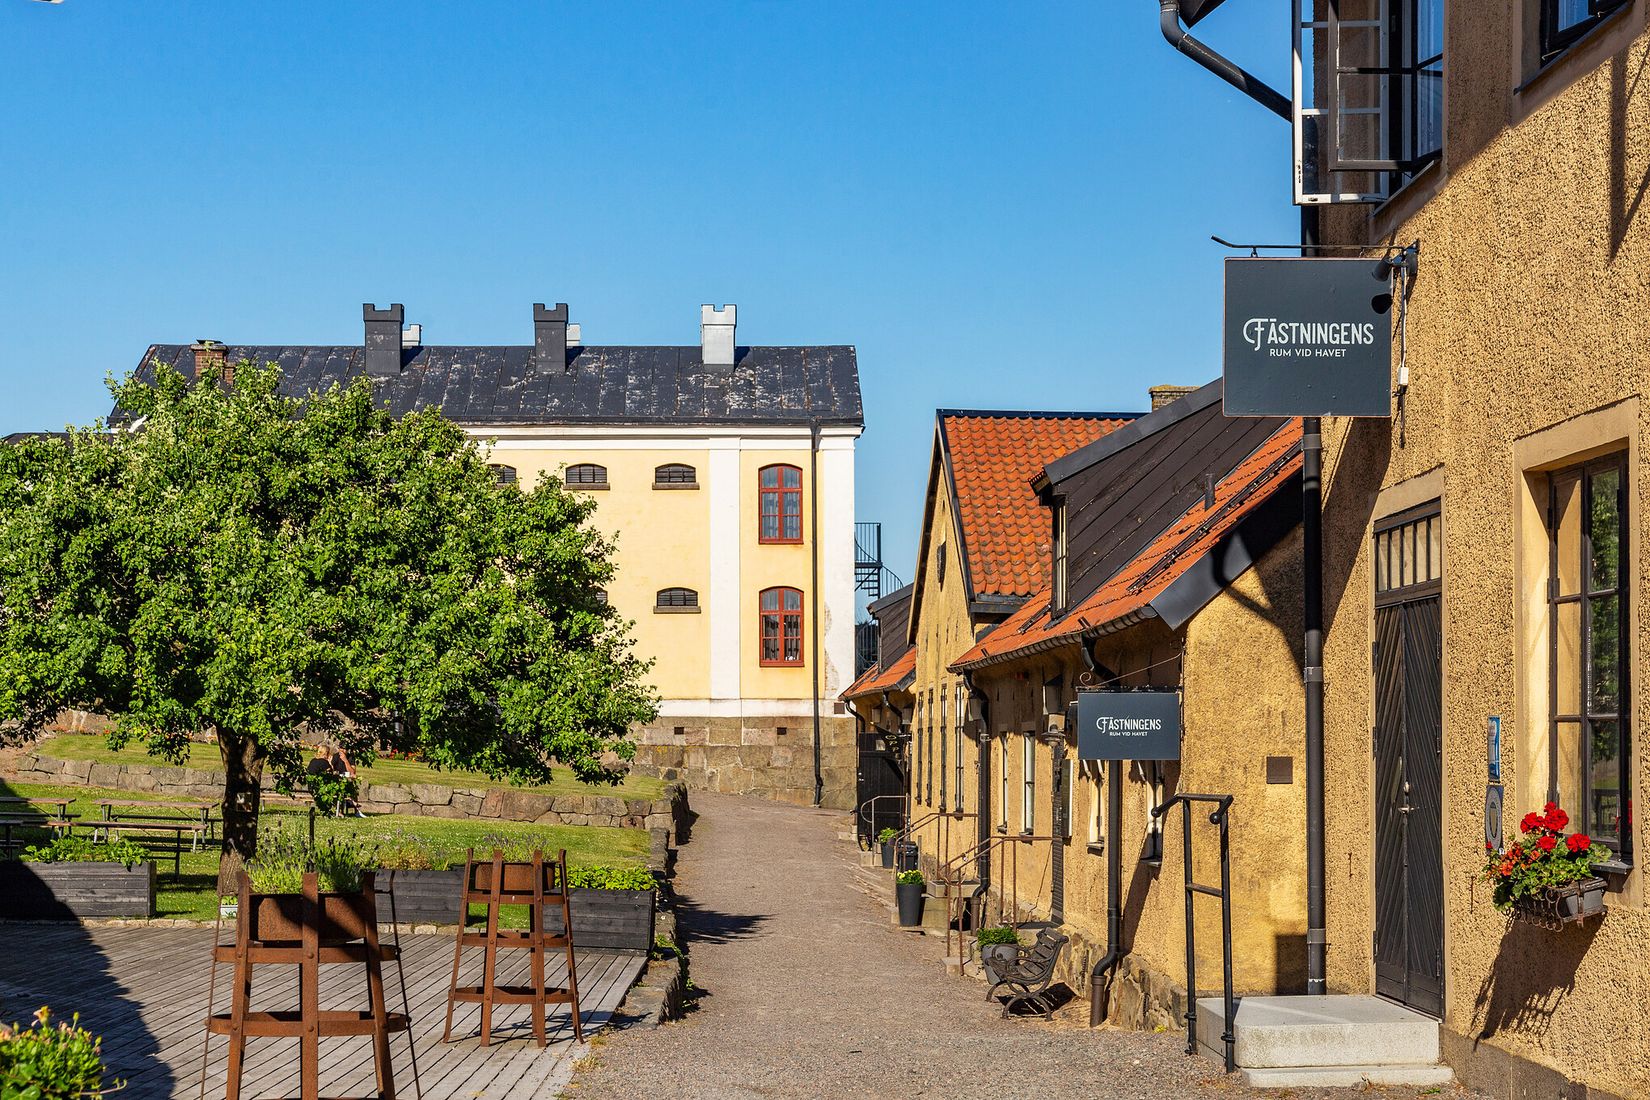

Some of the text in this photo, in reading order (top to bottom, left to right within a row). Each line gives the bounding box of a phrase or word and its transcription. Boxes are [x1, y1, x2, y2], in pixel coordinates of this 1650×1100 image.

[1269, 348, 1347, 357] RUM VID HAVET
